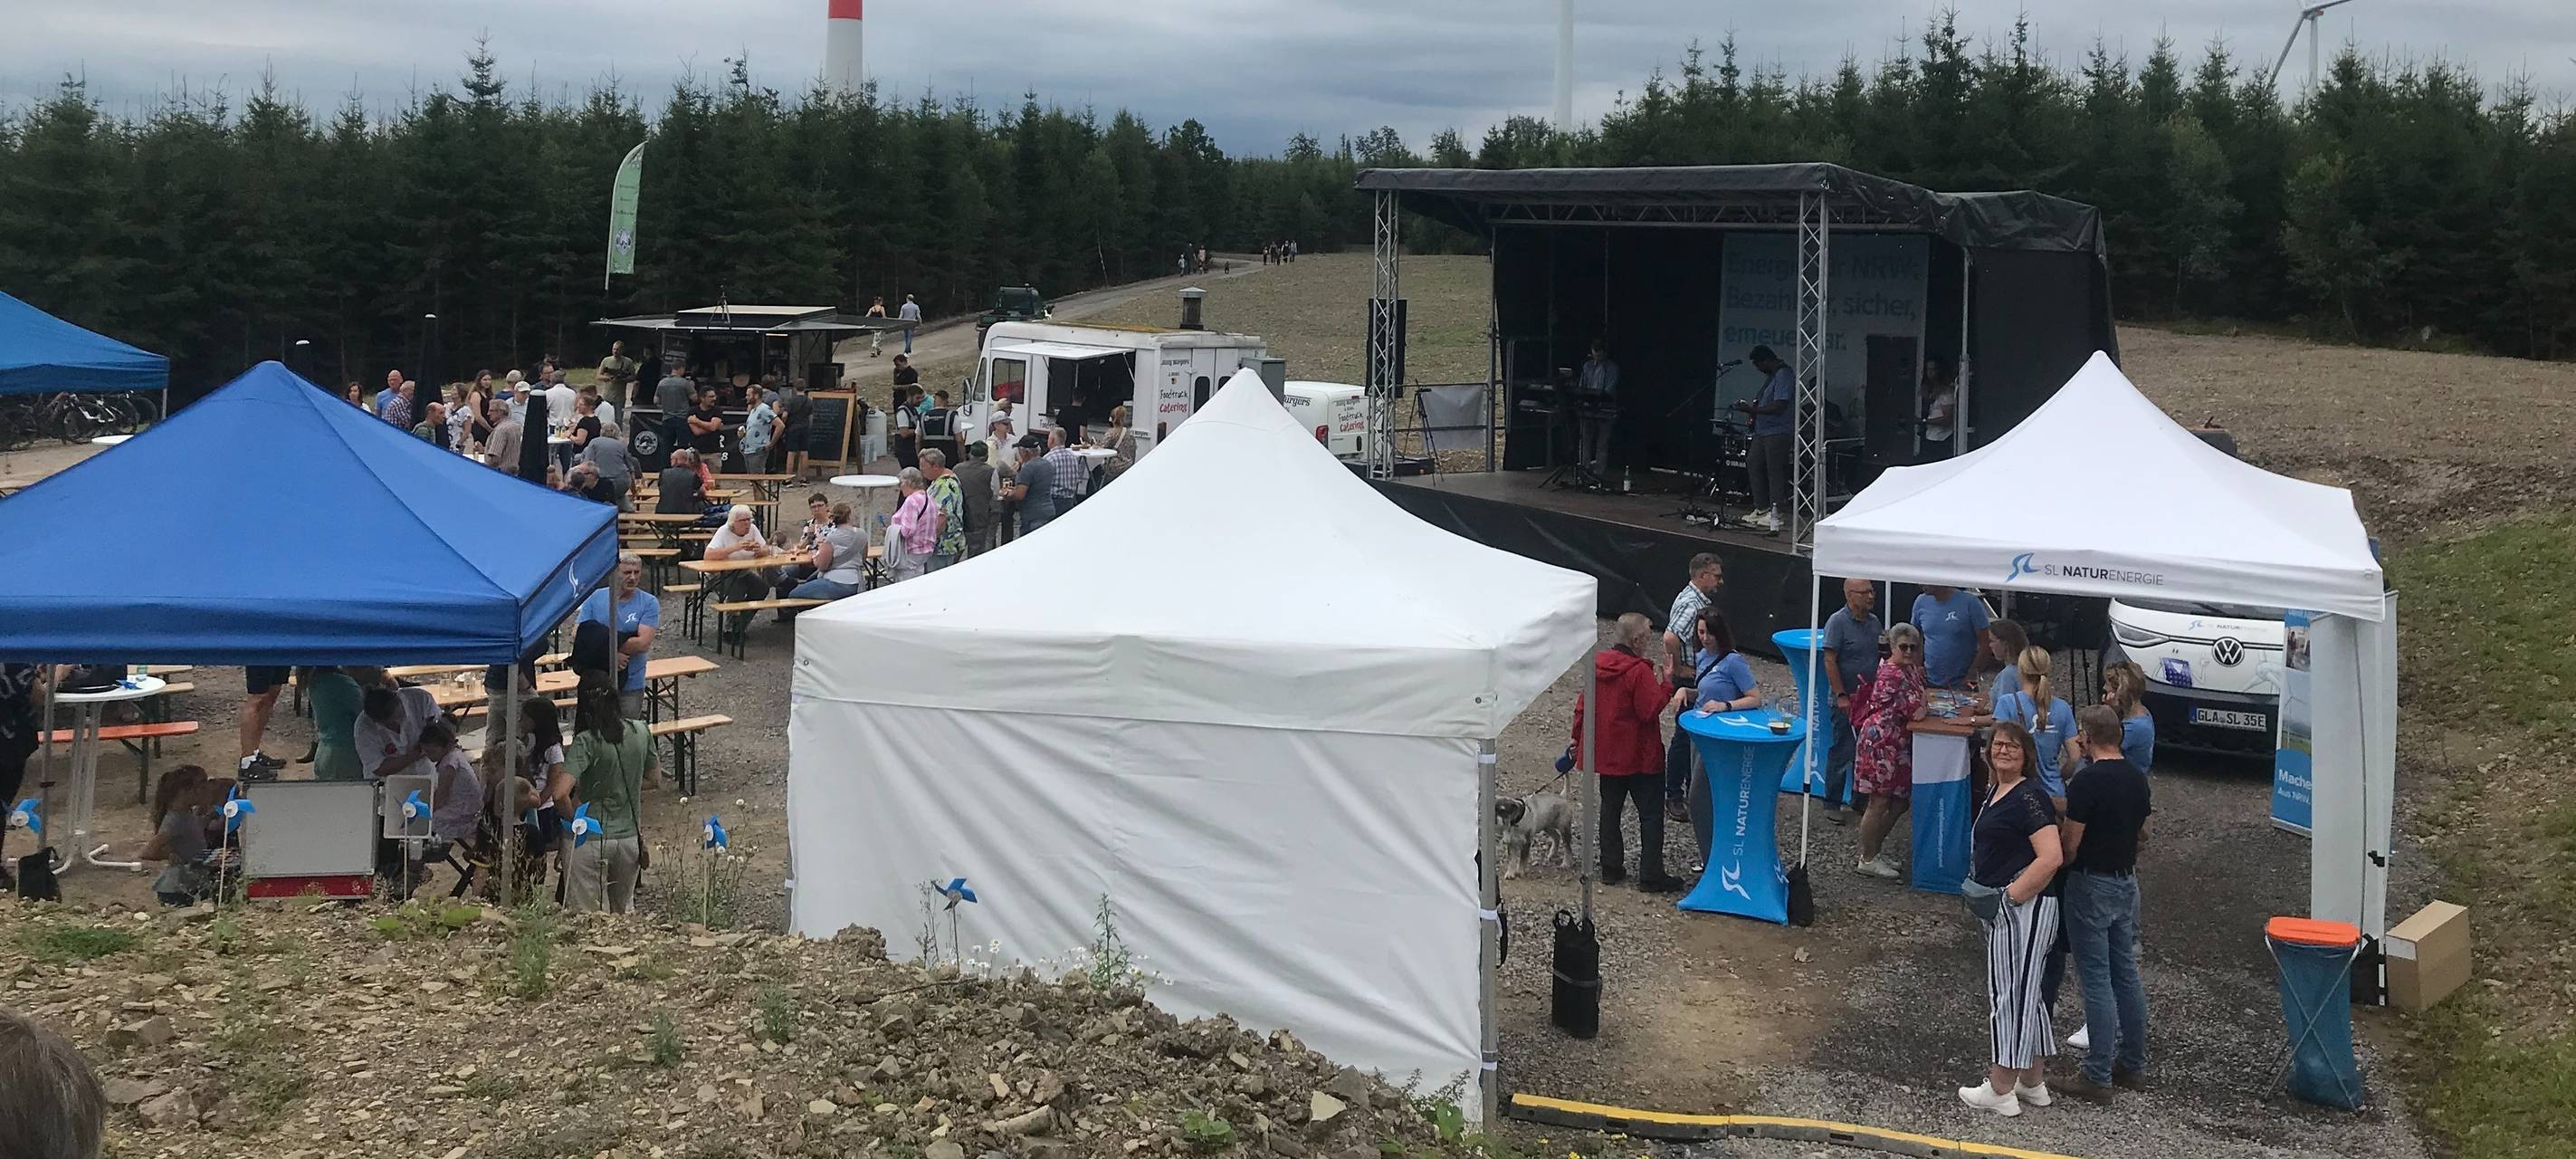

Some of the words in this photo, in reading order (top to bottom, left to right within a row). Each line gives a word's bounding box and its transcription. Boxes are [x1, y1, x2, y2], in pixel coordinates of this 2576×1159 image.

[1843, 292, 1917, 321] sicher,
[1283, 396, 1312, 407] urgers
[2044, 563, 2060, 577] SL
[2062, 565, 2165, 586] NATURENERGIE
[2197, 709, 2219, 723] GLA
[2226, 713, 2241, 725] SL
[2243, 714, 2266, 728] 35E
[1732, 838, 1745, 856] SL
